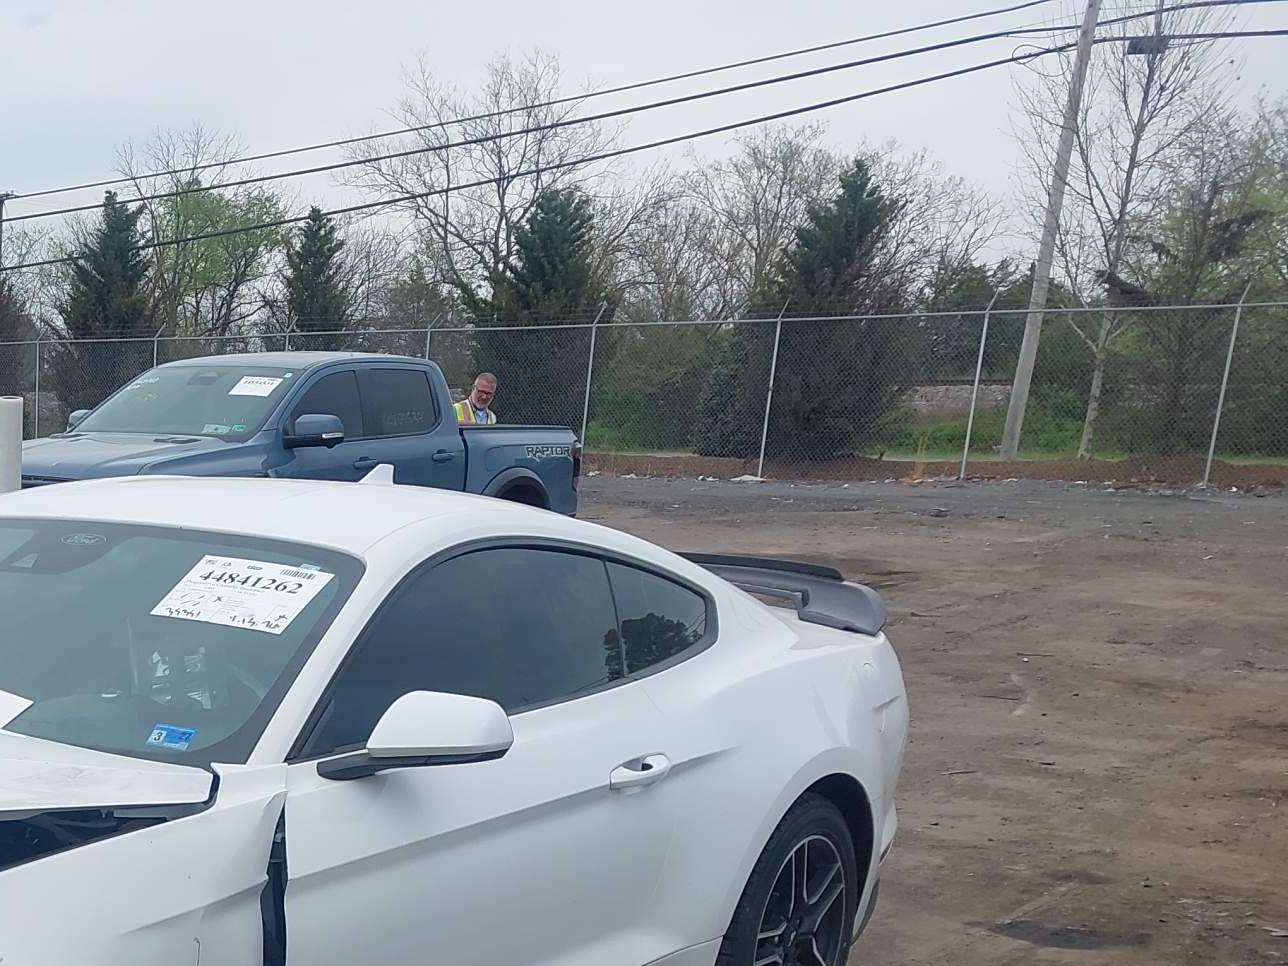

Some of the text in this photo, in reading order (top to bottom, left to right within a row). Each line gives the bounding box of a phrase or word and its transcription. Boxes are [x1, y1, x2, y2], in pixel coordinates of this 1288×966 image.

[525, 446, 571, 458] RAPTOR
[199, 569, 303, 594] 44841262
[153, 731, 163, 742] 3
